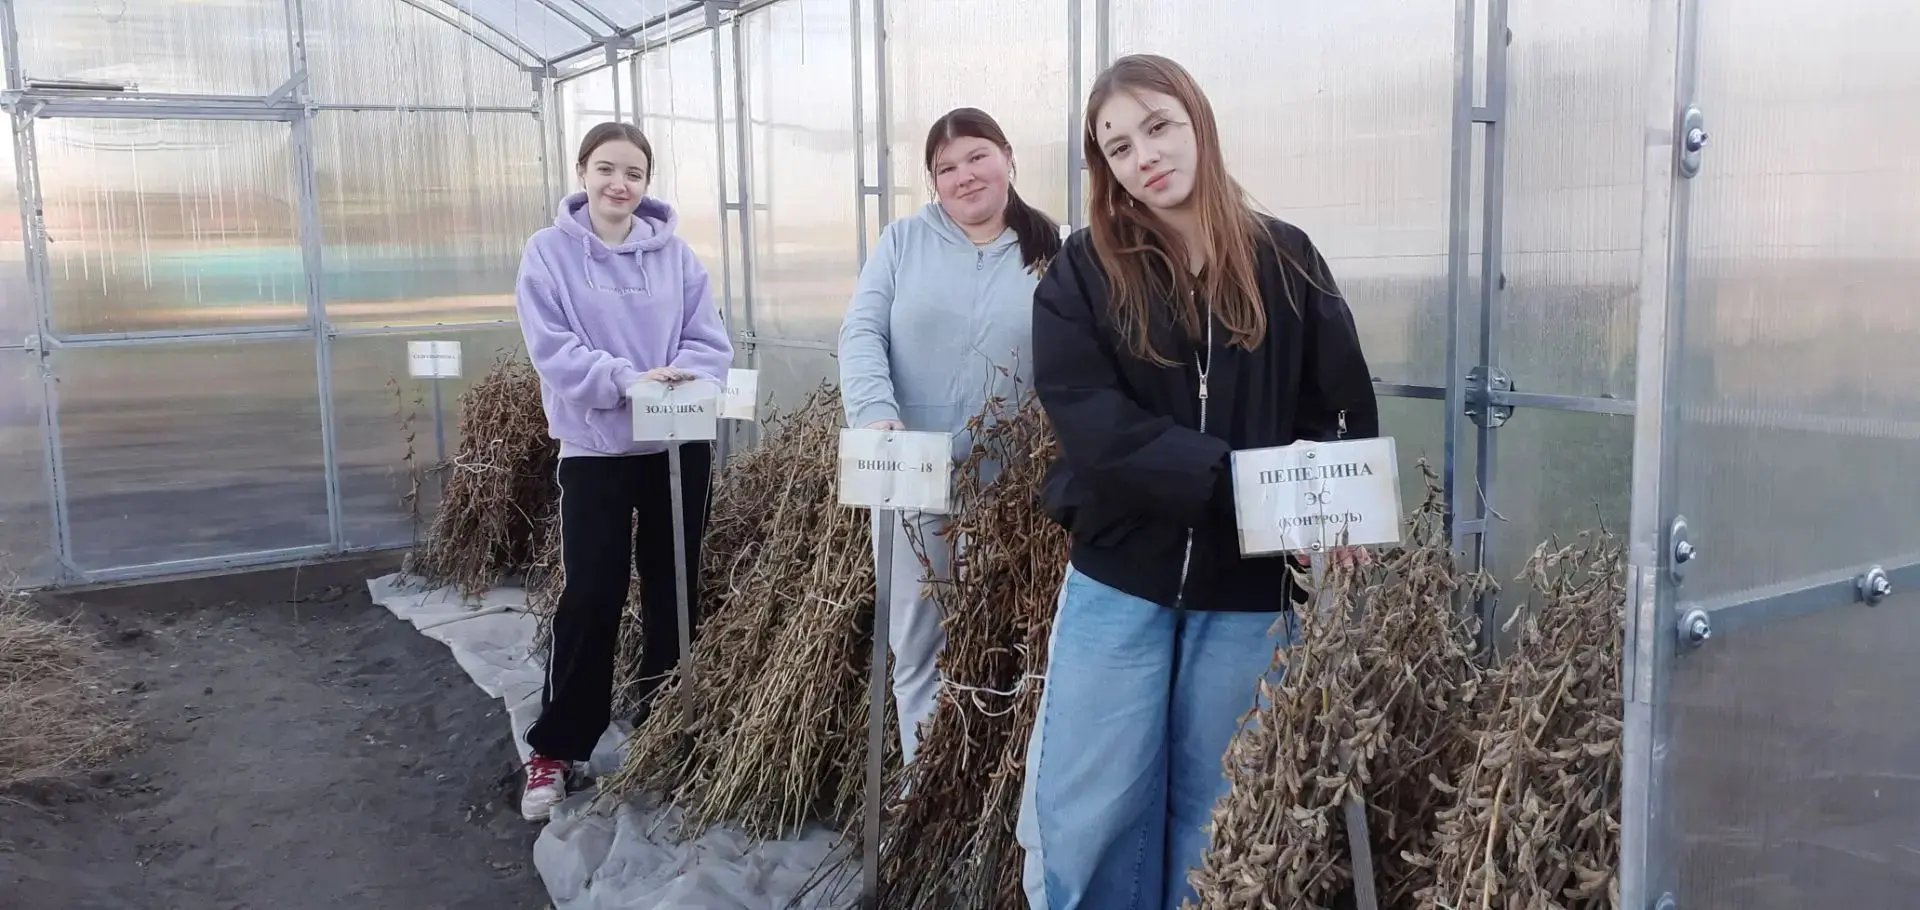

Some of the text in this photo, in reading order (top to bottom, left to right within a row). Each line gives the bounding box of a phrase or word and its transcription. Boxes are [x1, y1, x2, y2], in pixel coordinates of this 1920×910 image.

[644, 404, 704, 414] ЗОЛУШКА
[858, 459, 906, 472] ВНИИС
[920, 462, 933, 473] 18
[1258, 462, 1374, 485] ПЕПЕЛИНА
[1304, 491, 1332, 506] ЭС
[1278, 512, 1363, 529] (КОНТРОЛЬ)
